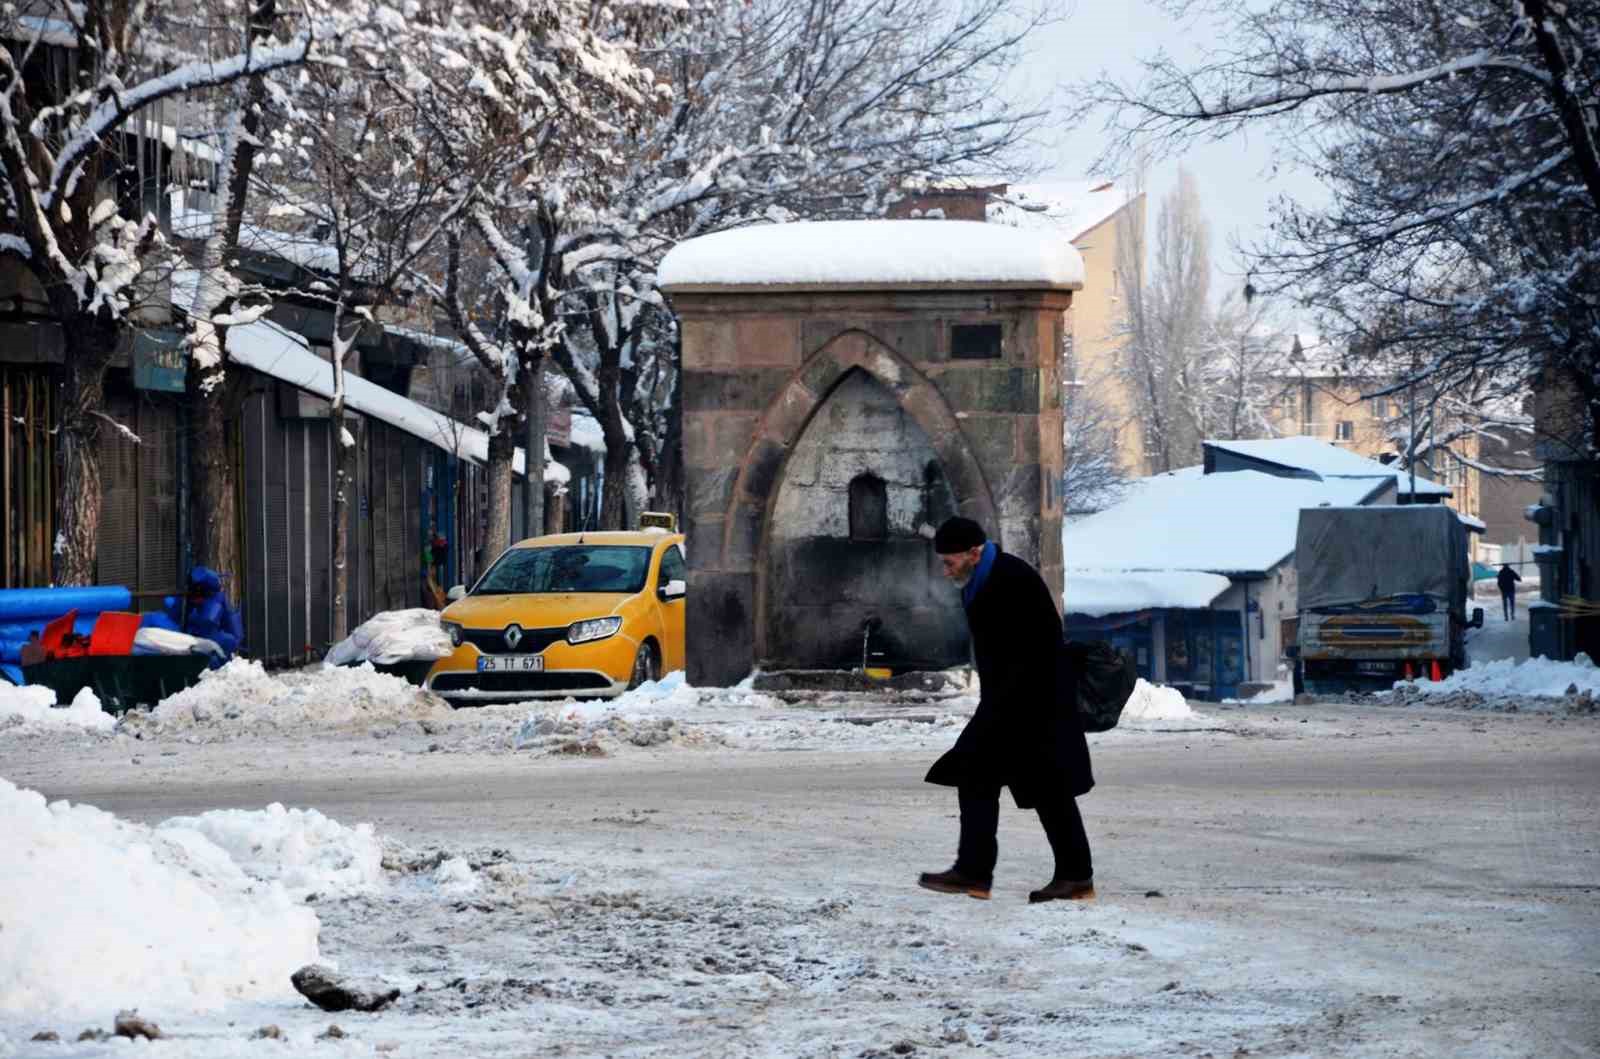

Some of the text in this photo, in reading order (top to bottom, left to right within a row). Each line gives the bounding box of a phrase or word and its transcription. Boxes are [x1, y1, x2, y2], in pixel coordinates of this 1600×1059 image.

[484, 657, 541, 670] 25 TT 671
